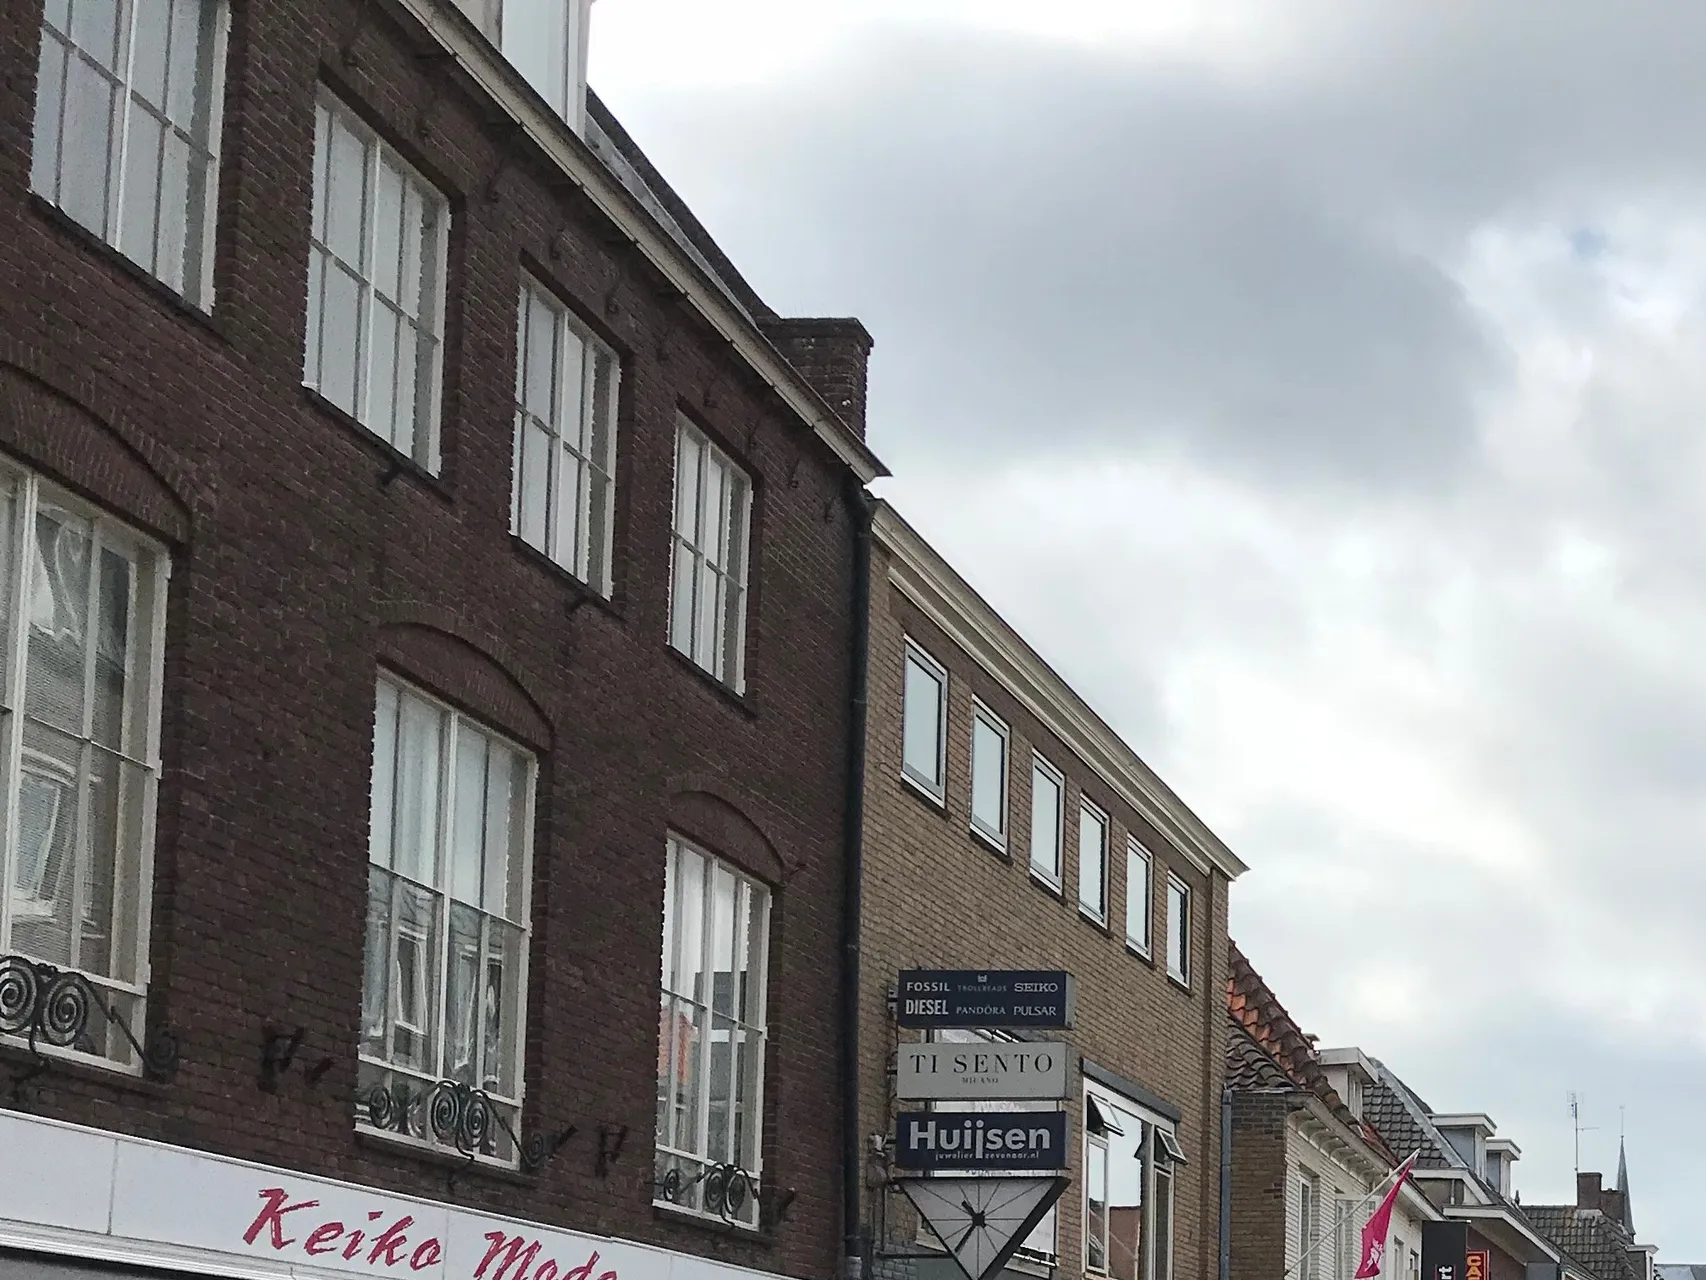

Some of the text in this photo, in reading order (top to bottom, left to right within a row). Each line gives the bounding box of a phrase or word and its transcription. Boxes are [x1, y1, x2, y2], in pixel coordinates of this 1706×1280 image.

[906, 982, 950, 992] FOSSIL
[1014, 982, 1058, 993] SEIKO
[905, 999, 949, 1015] DIESEL
[1014, 1006, 1056, 1016] PULSAR
[910, 1053, 1052, 1073] TI SENTO
[910, 1119, 1051, 1159] Huijsen
[243, 1187, 442, 1268] Keiko
